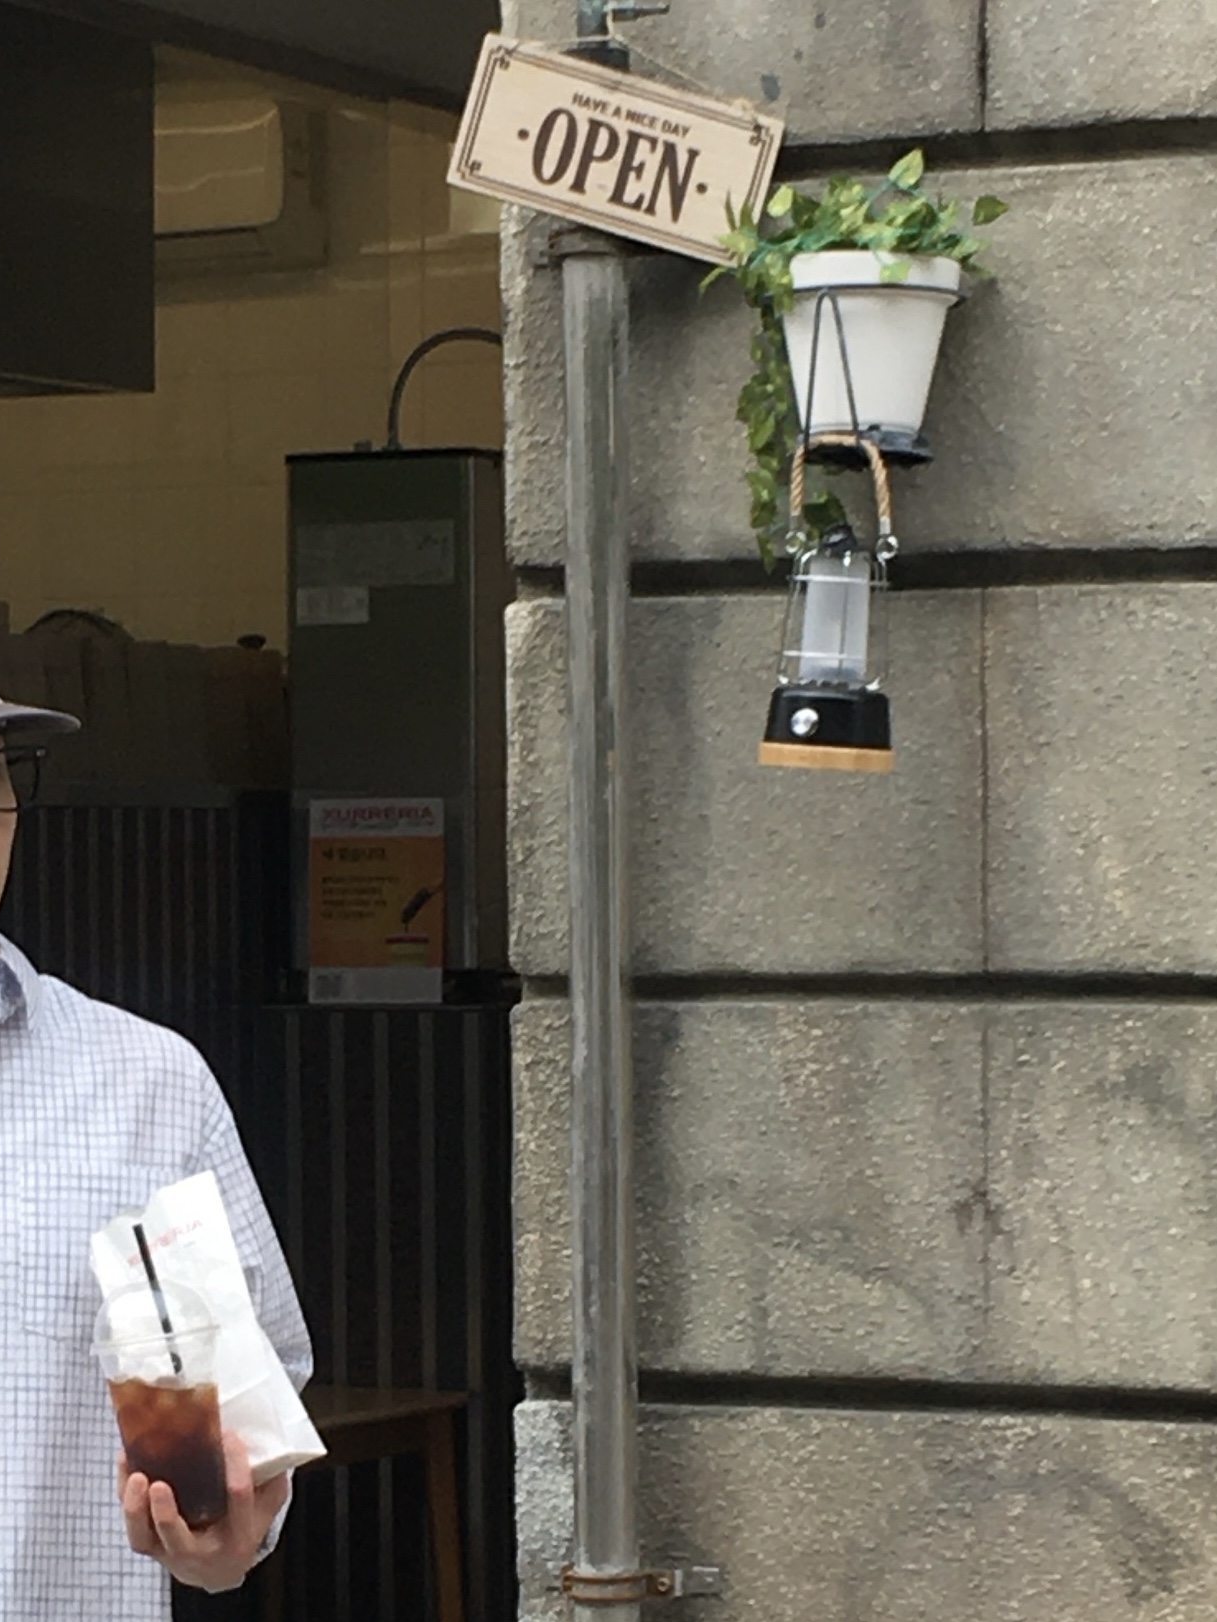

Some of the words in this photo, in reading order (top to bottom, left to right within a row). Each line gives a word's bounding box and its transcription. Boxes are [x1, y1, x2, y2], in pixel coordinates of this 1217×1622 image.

[571, 91, 610, 114] HAVE
[612, 105, 622, 119] A
[625, 108, 658, 129] NICE
[661, 119, 691, 138] DAY
[531, 107, 702, 224] OPEN
